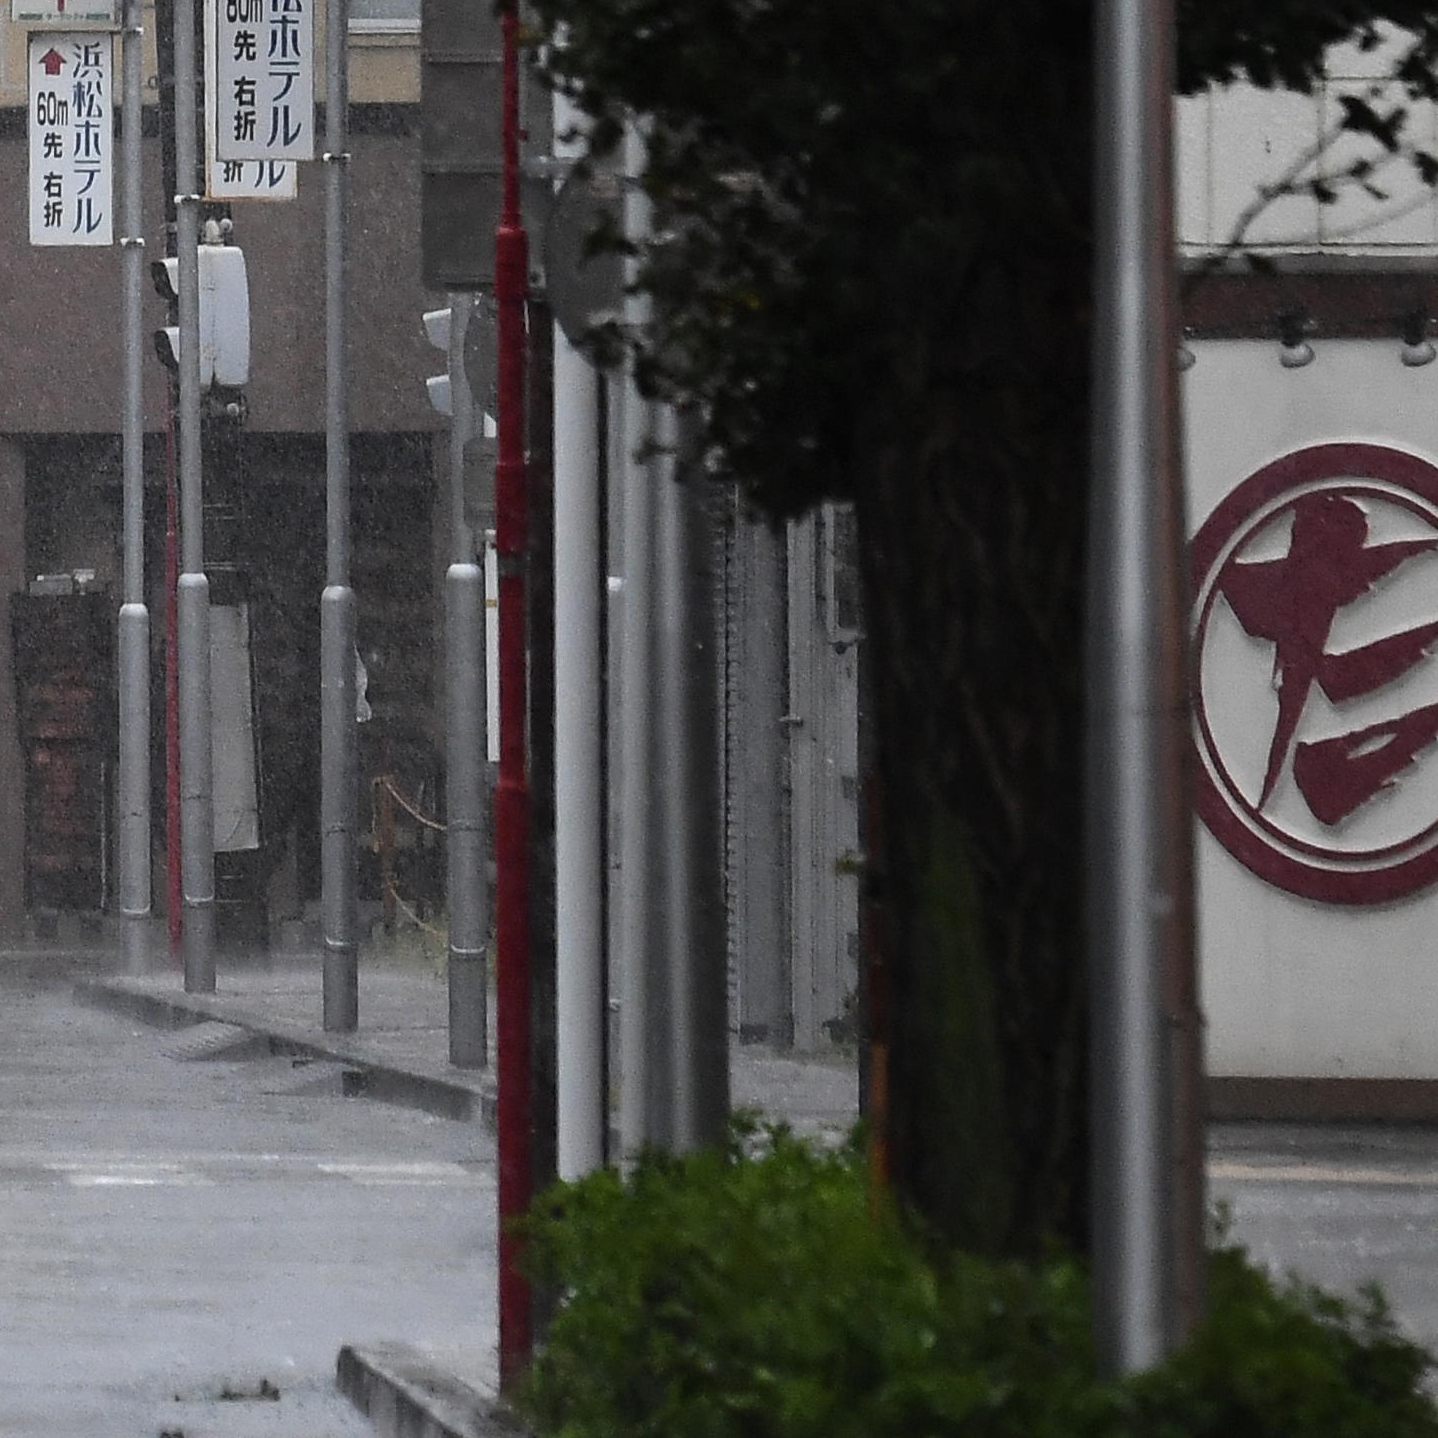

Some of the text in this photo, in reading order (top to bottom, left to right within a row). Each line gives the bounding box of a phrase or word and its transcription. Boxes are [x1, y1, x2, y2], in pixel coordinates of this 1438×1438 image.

[73, 42, 103, 234] 浜松ホテル
